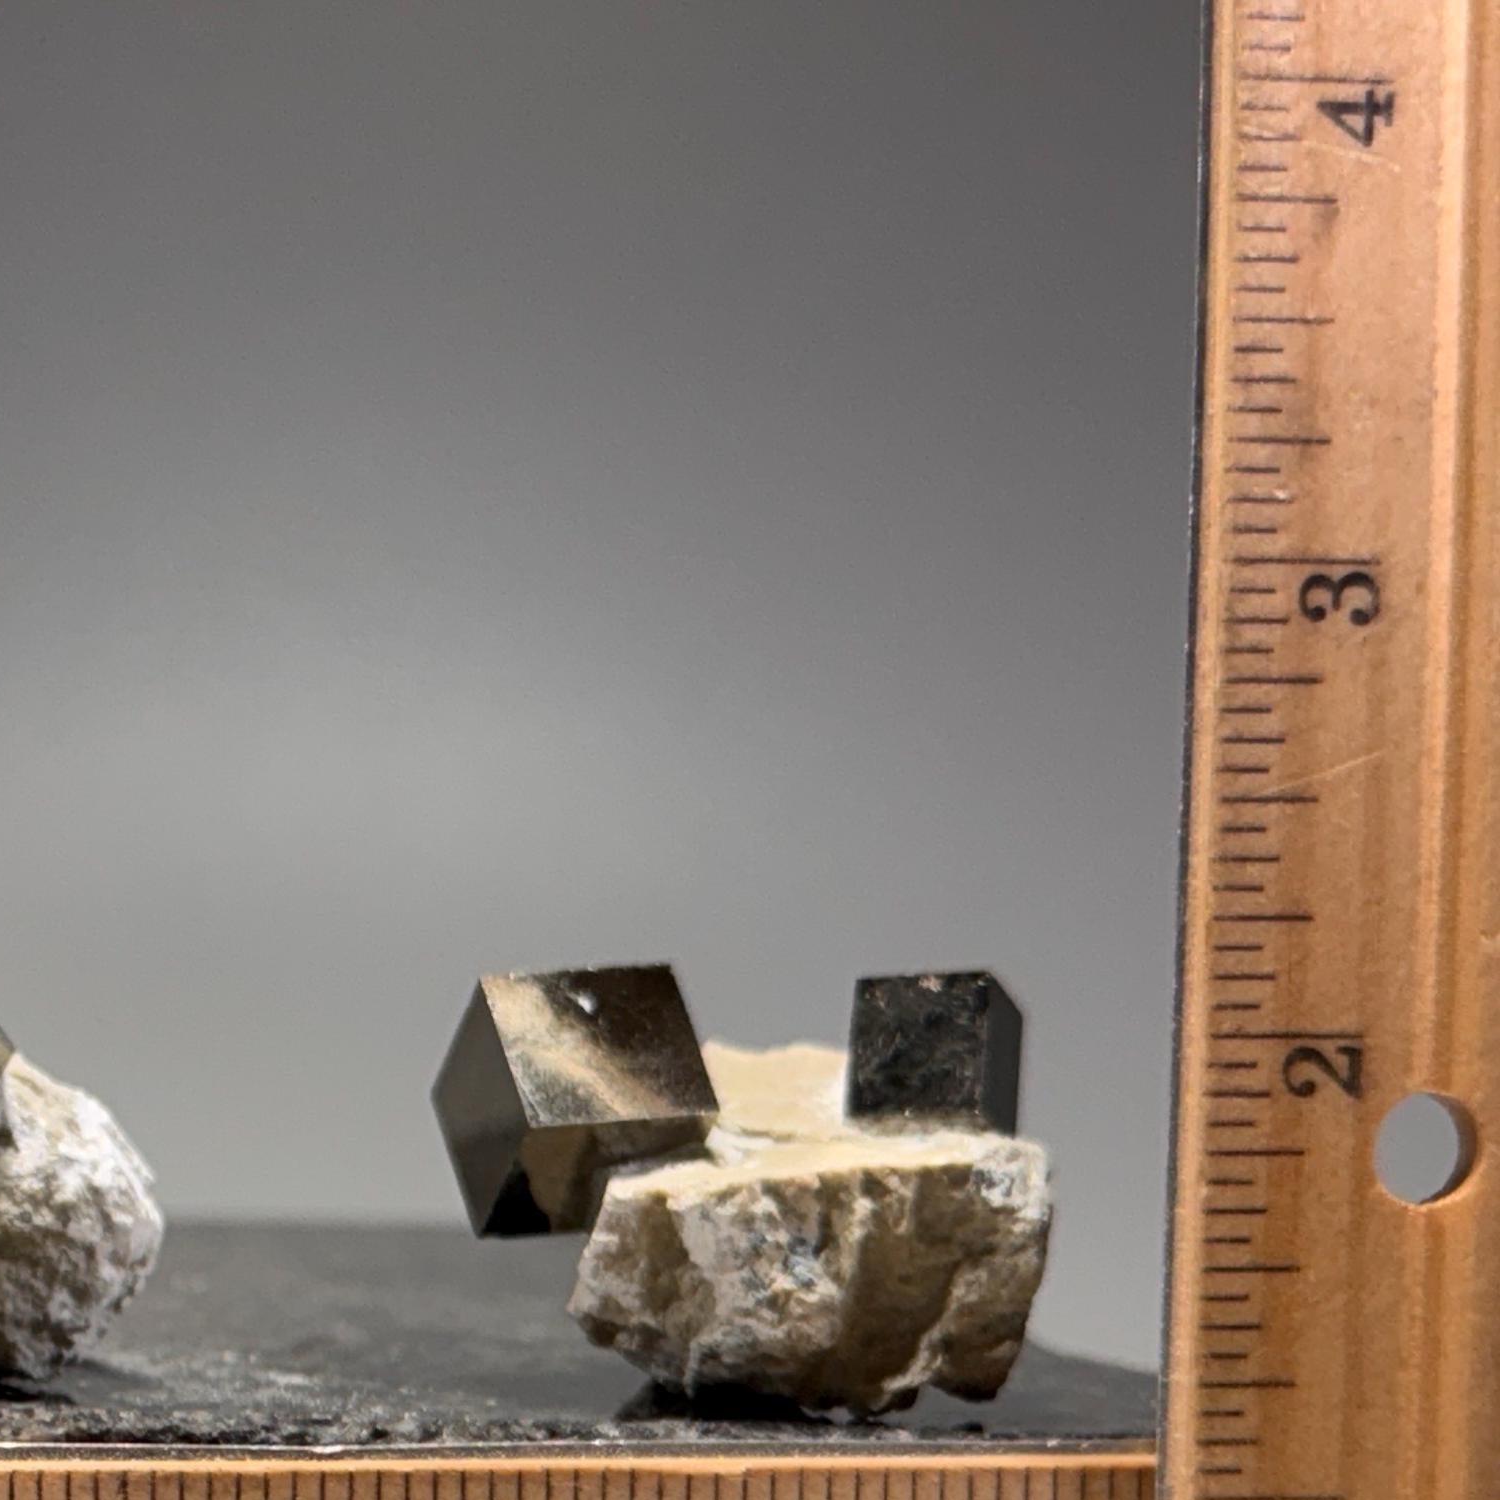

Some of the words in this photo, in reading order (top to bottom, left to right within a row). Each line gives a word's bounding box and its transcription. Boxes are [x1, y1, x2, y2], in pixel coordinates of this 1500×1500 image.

[1316, 89, 1396, 147] 4
[1299, 571, 1382, 626] 3
[1282, 1045, 1362, 1098] 2
